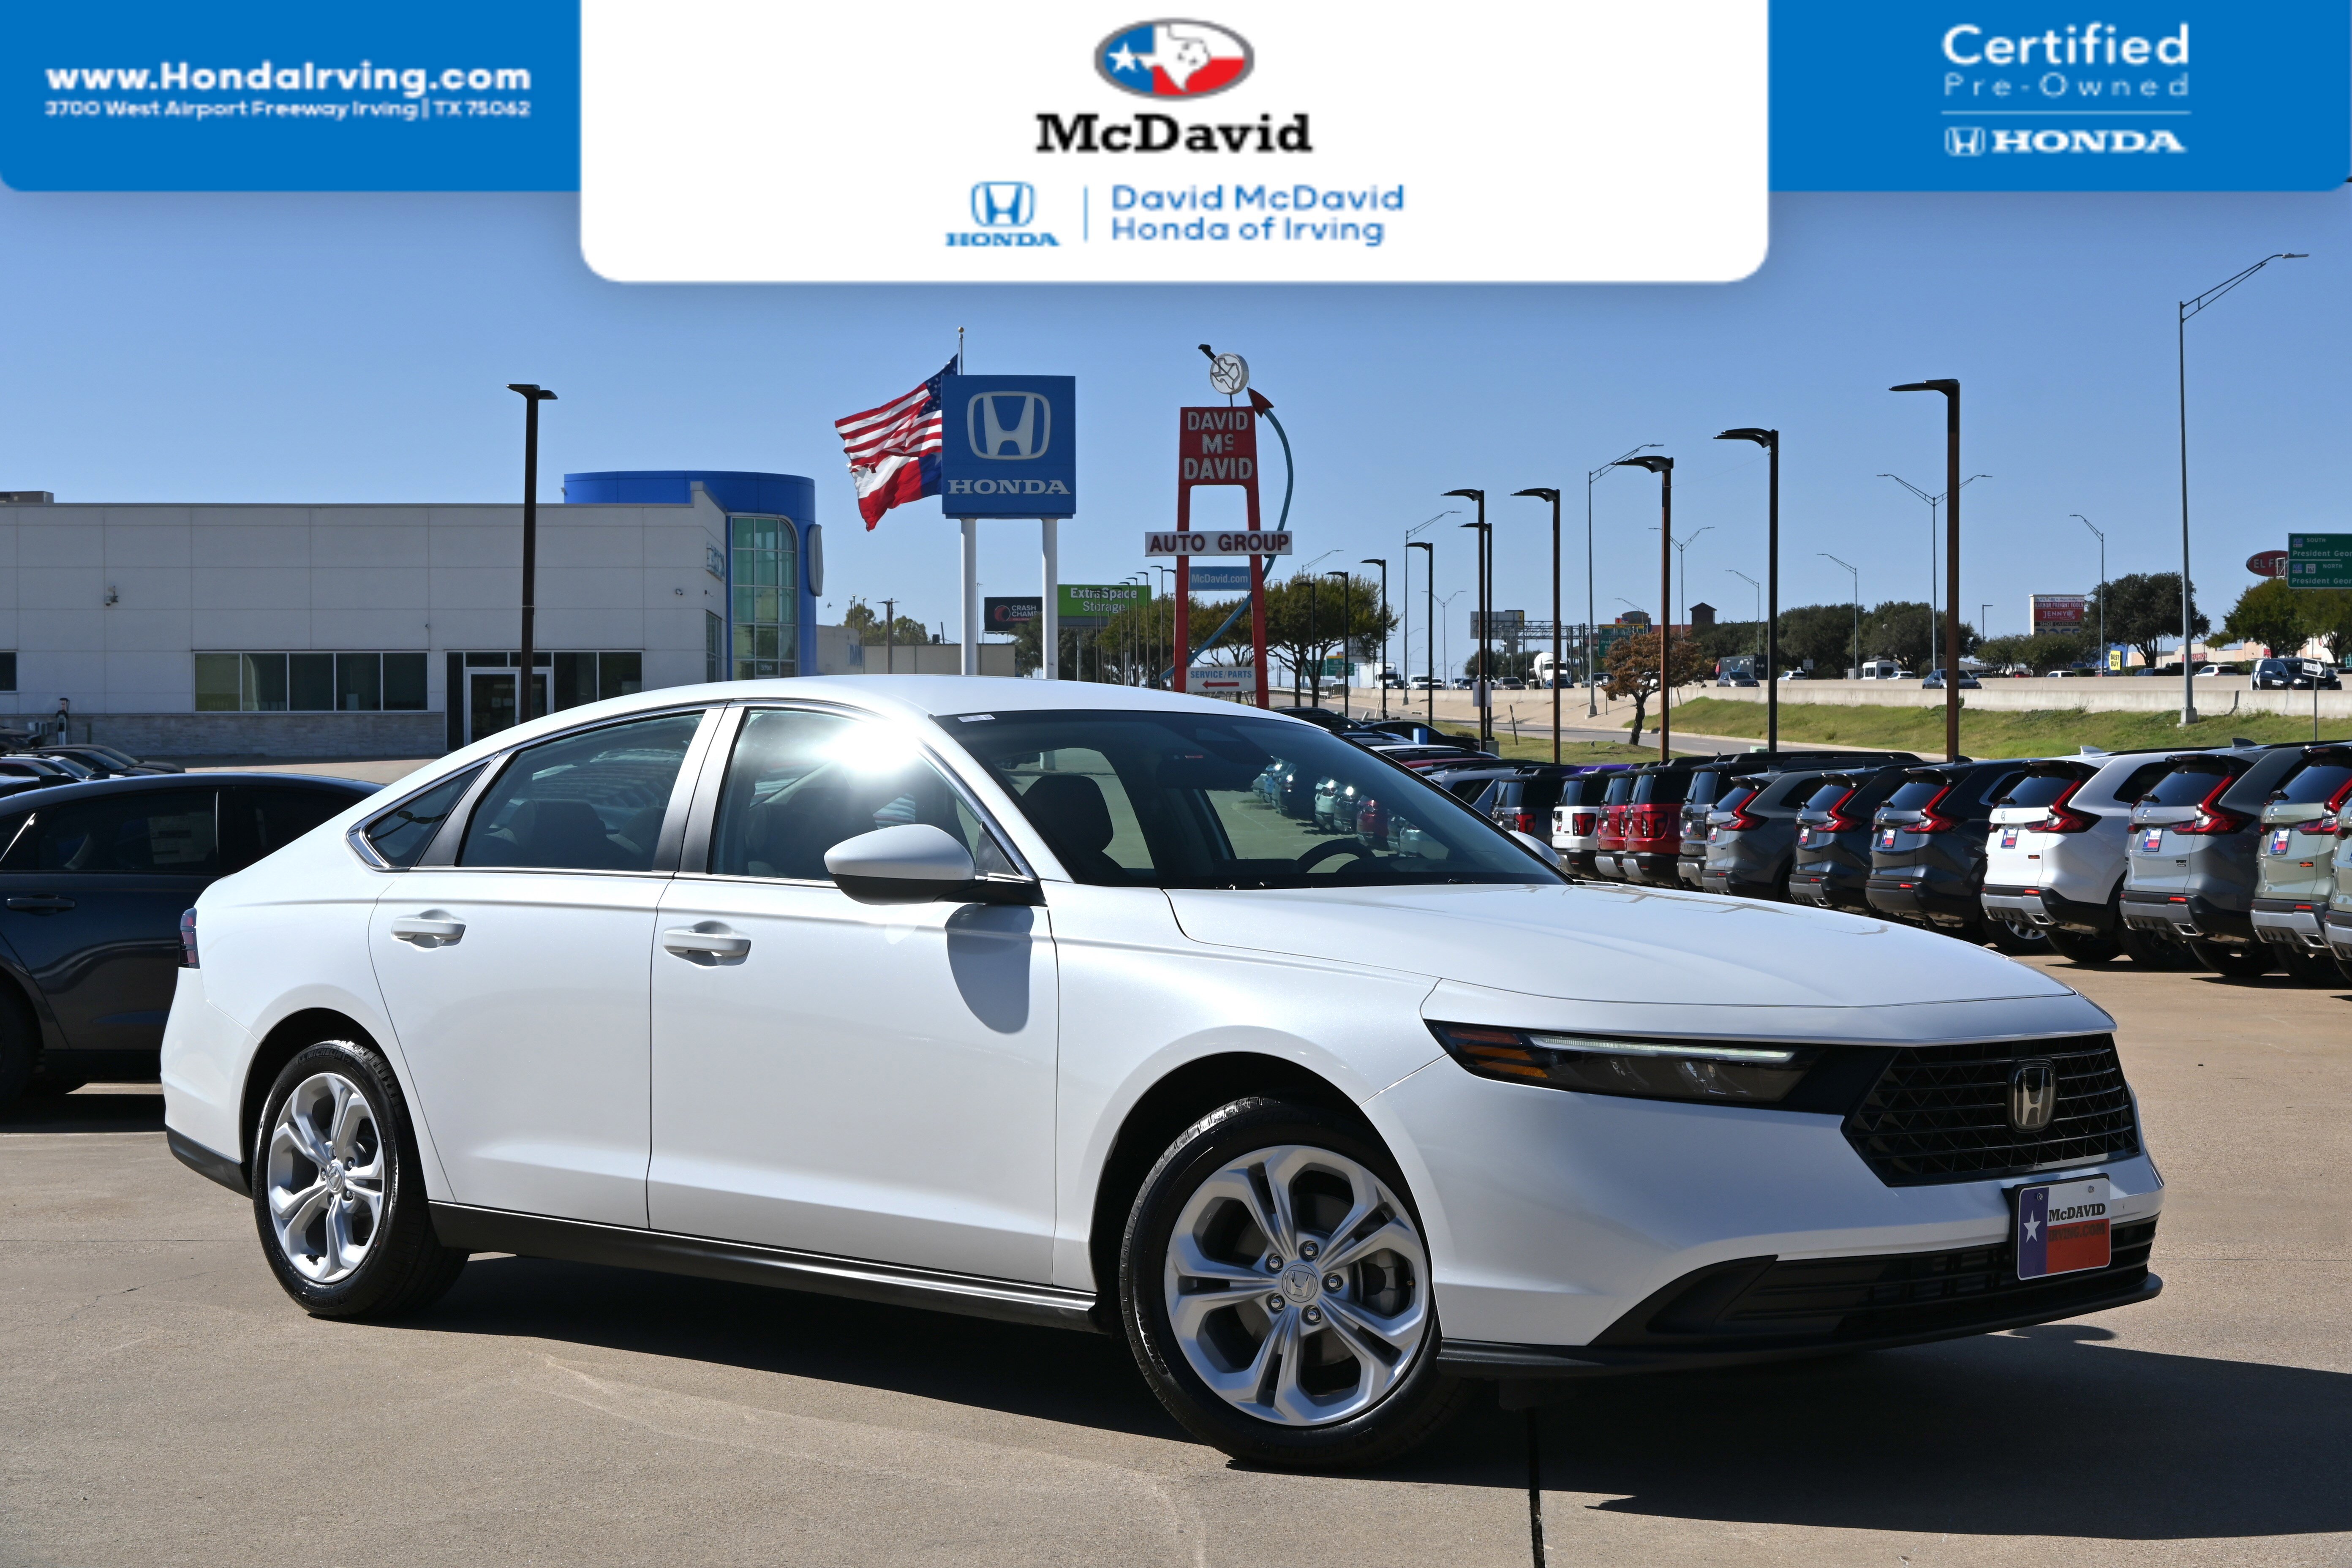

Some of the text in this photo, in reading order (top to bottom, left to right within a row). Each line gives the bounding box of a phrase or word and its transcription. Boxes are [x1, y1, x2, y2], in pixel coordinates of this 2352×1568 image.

[1187, 411, 1248, 431] DAVID
[1202, 433, 1234, 455] Mc
[1184, 457, 1253, 480] DAVID
[948, 480, 1070, 494] HONDA
[1149, 534, 1289, 552] AUTO GROUP
[2254, 559, 2265, 569] EL
[1192, 574, 1248, 583] McDavid.com
[1083, 601, 1126, 613] Storage
[2049, 1203, 2106, 1222] McDAVID
[2048, 1223, 2105, 1242] IRVING.COM
